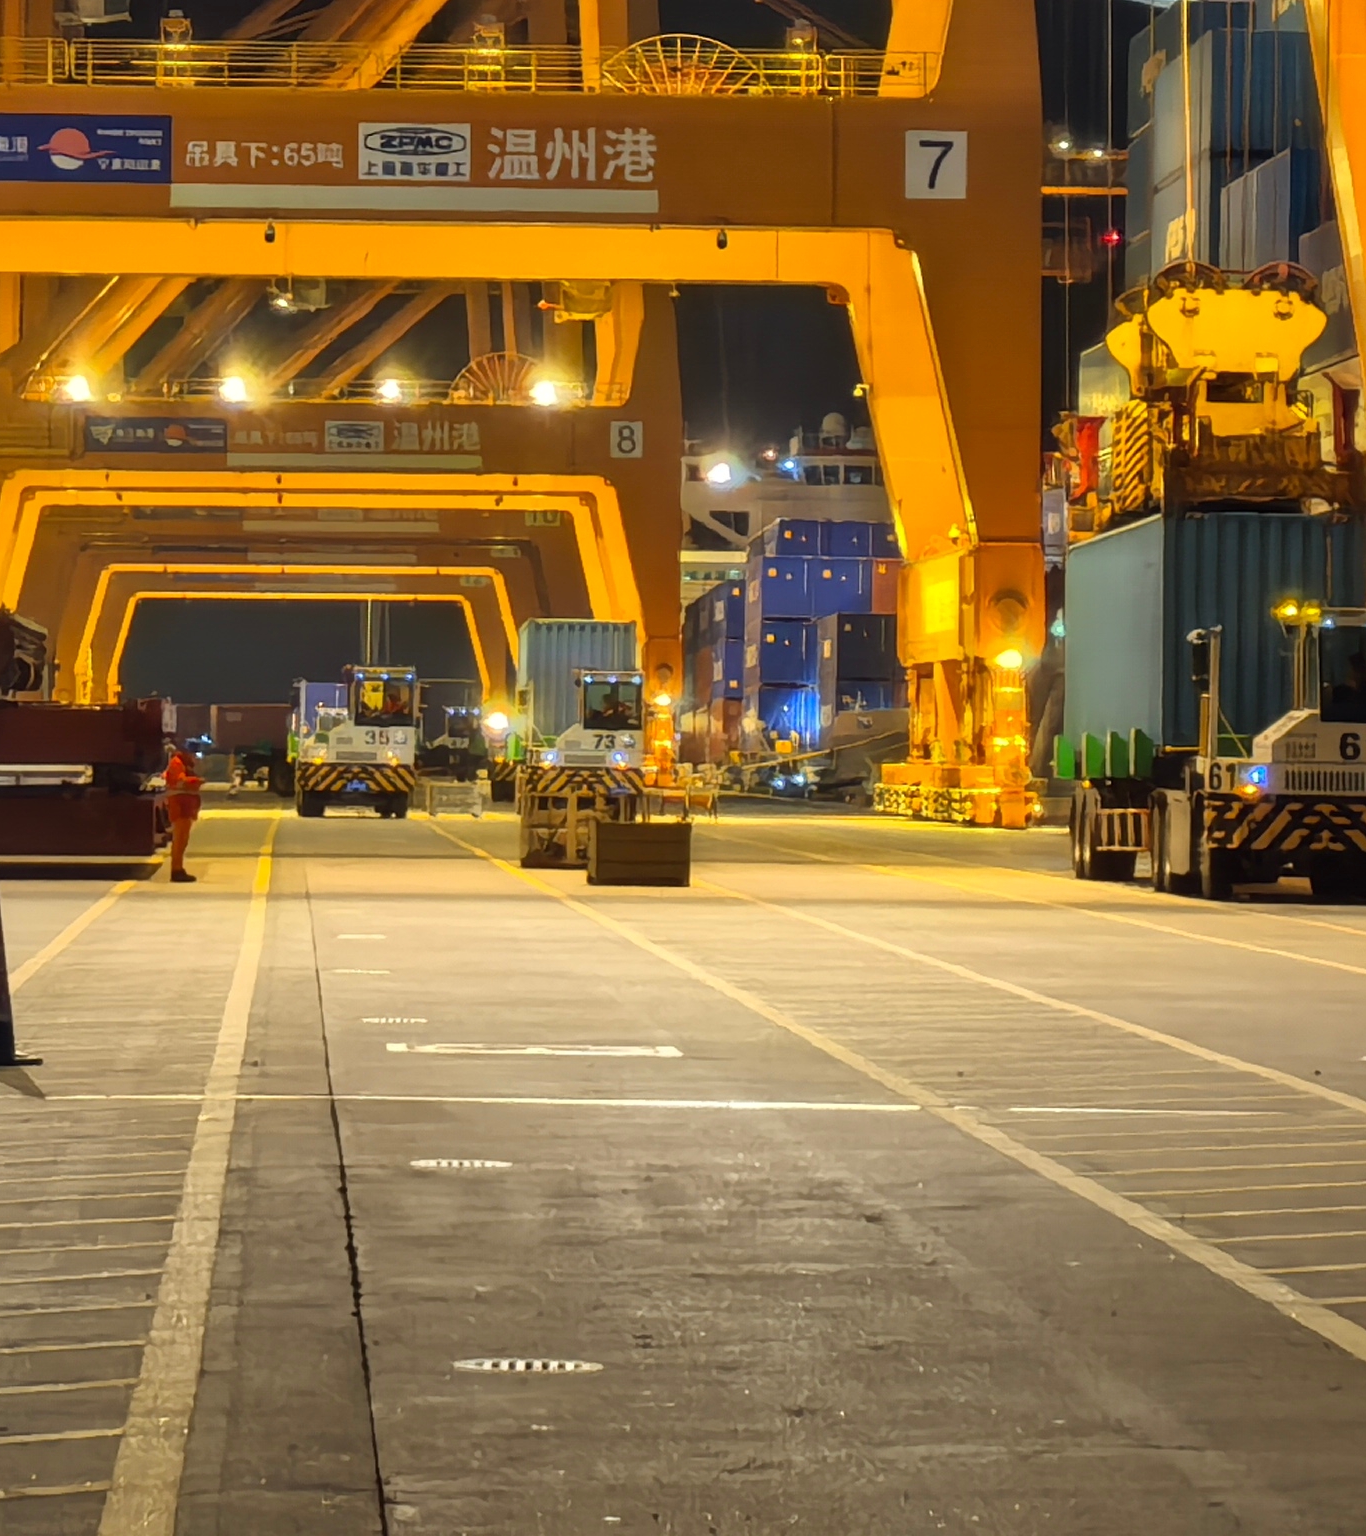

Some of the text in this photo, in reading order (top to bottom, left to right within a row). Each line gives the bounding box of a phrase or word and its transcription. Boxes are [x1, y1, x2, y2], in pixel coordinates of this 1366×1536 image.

[379, 133, 454, 152] ZPMC
[487, 126, 658, 183] 温州港
[919, 139, 954, 190] 7
[391, 420, 482, 452] 温州港
[617, 425, 637, 454] 8
[593, 734, 616, 750] 73
[1208, 762, 1236, 791] 61
